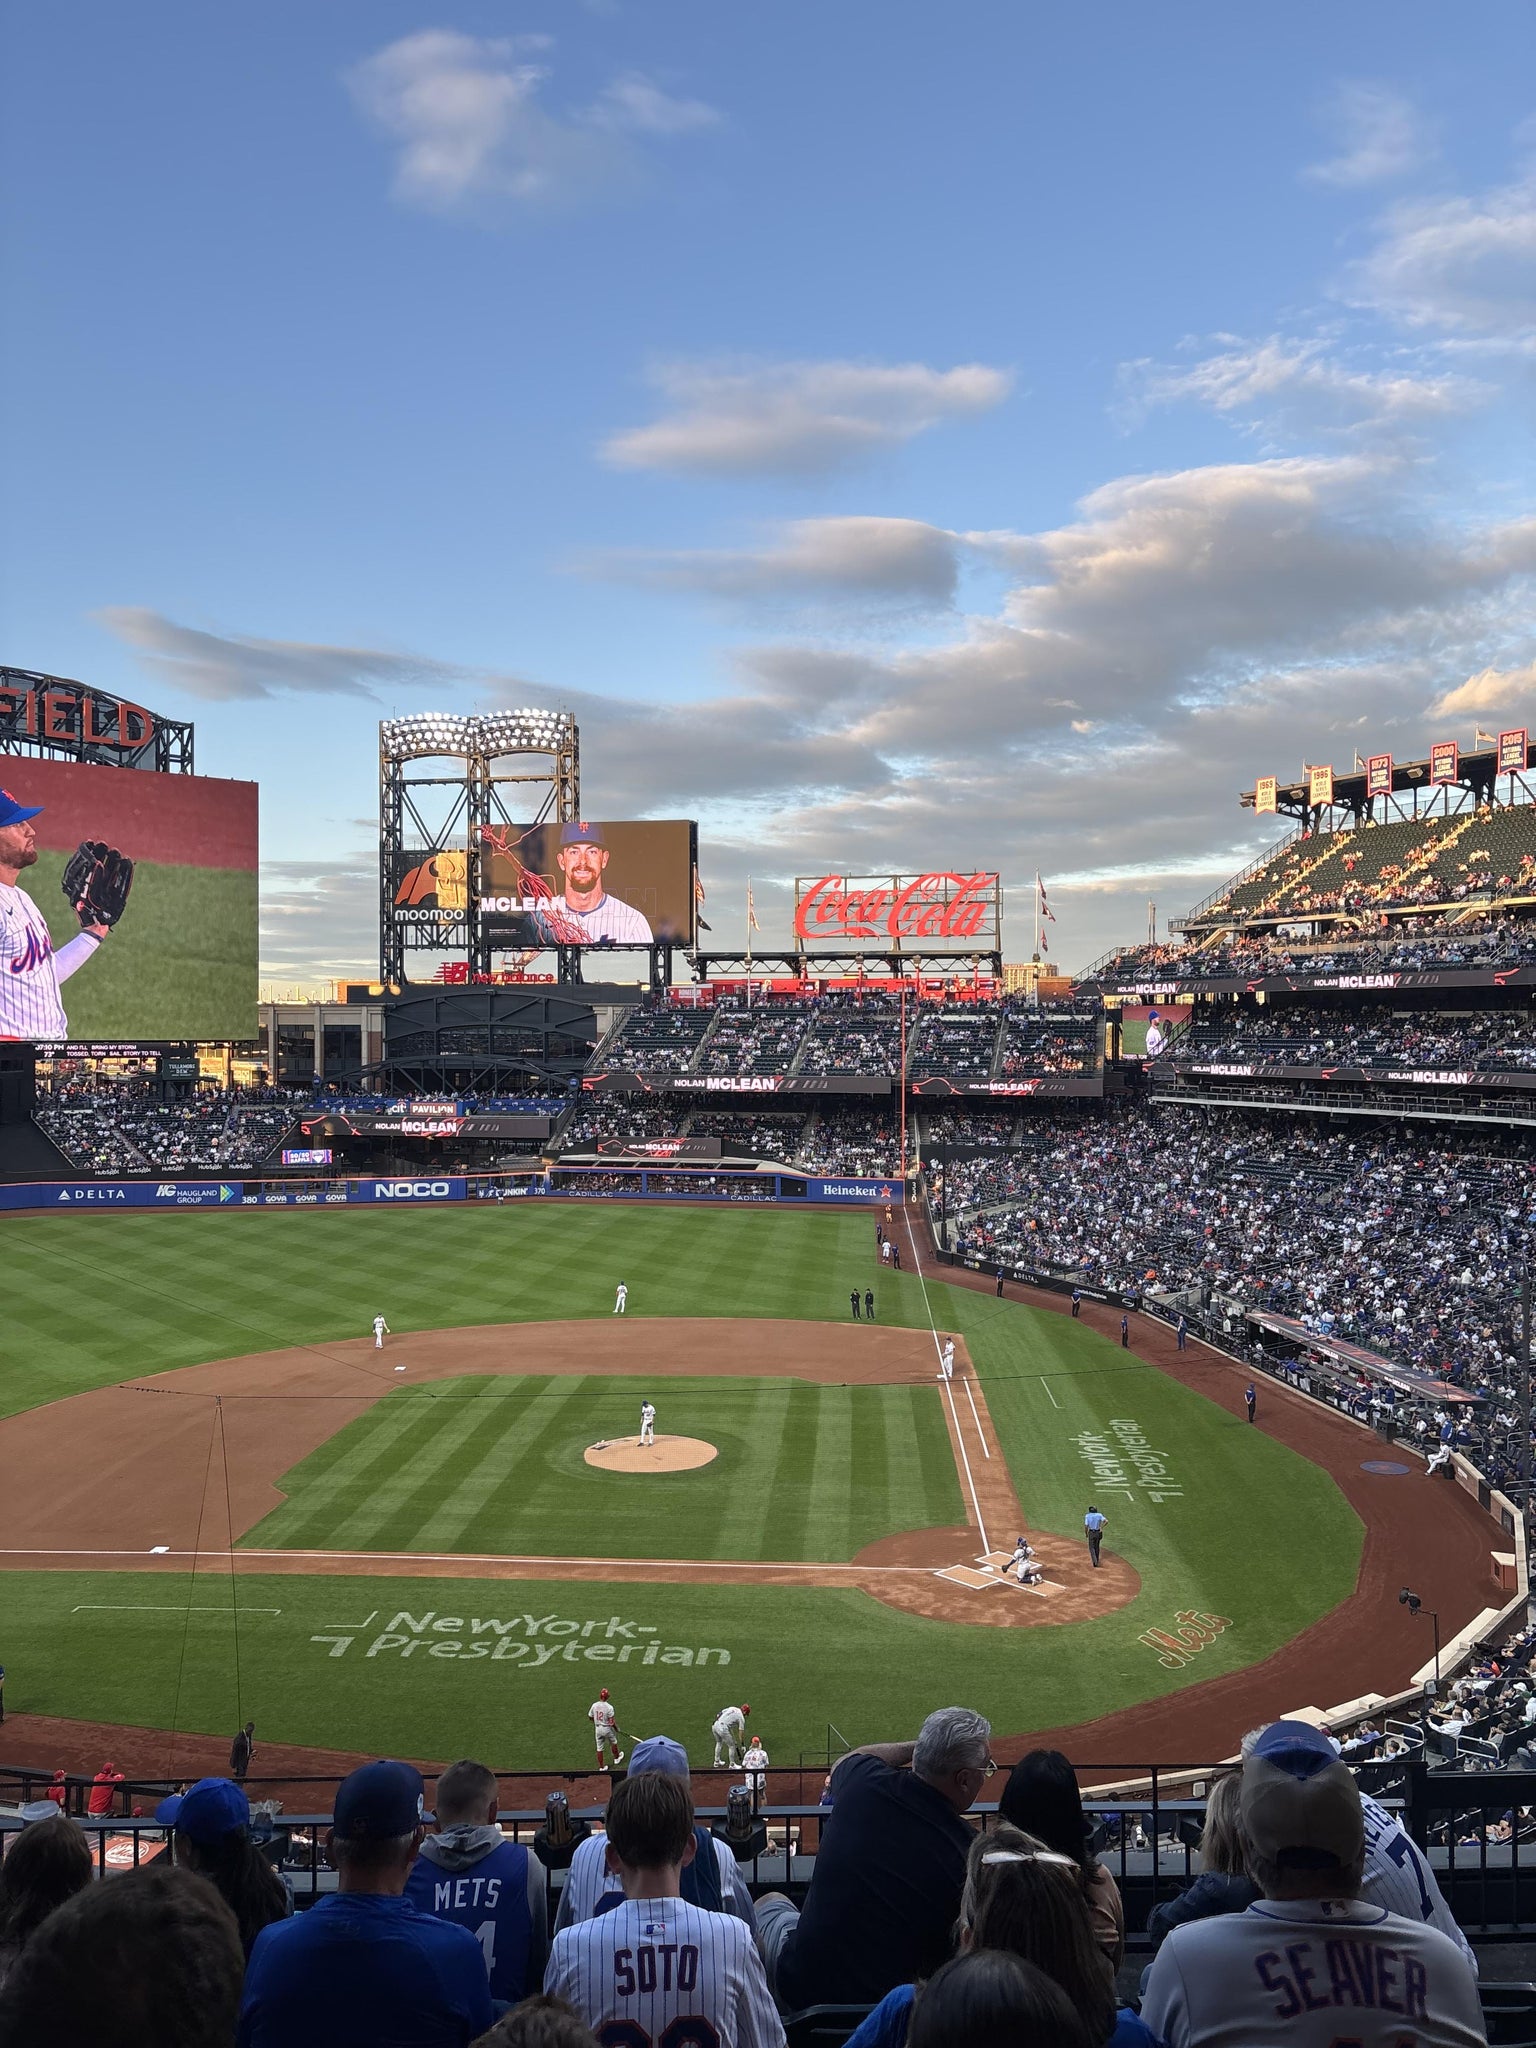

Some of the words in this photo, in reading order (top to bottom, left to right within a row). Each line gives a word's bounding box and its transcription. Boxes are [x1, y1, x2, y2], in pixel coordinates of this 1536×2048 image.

[1503, 733, 1522, 746] 2015
[1434, 746, 1454, 757] 2000
[1371, 758, 1388, 769] 1973
[1260, 780, 1273, 790] 1969
[481, 896, 566, 912] MCLEAN
[795, 872, 999, 938] Coca-Cola
[395, 909, 464, 921] moomoo
[472, 974, 498, 982] new
[501, 971, 554, 982] balance
[1339, 976, 1393, 988] MCLEAN
[1136, 984, 1175, 994] MCLEAN
[1210, 1065, 1251, 1075] MCLEAN
[1388, 1072, 1412, 1080] NOLAN
[1413, 1071, 1467, 1084] MCLEAN
[674, 1079, 705, 1087] NOLAN
[706, 1078, 775, 1090] MCLEAN
[989, 1083, 1033, 1092] MCLEAN
[401, 1121, 456, 1132] MCLEAN
[128, 1166, 151, 1174] HubSpot
[162, 1164, 185, 1172] HubSpot
[198, 1163, 222, 1171] HubSpot
[229, 1162, 253, 1170] HubSpot
[95, 1168, 119, 1176] HubSpot
[75, 1189, 125, 1199] DELTA
[375, 1182, 449, 1198] NOCO
[823, 1185, 876, 1197] Heineken
[242, 1196, 258, 1204] 380
[1138, 1609, 1233, 1669] Mets
[365, 1634, 732, 1667] Presbyterian
[596, 1711, 604, 1720] 12
[1385, 1832, 1434, 1921] 7
[435, 1878, 502, 1912] METS
[614, 1944, 699, 1996] SOTO
[1254, 1939, 1430, 2022] SEAVER
